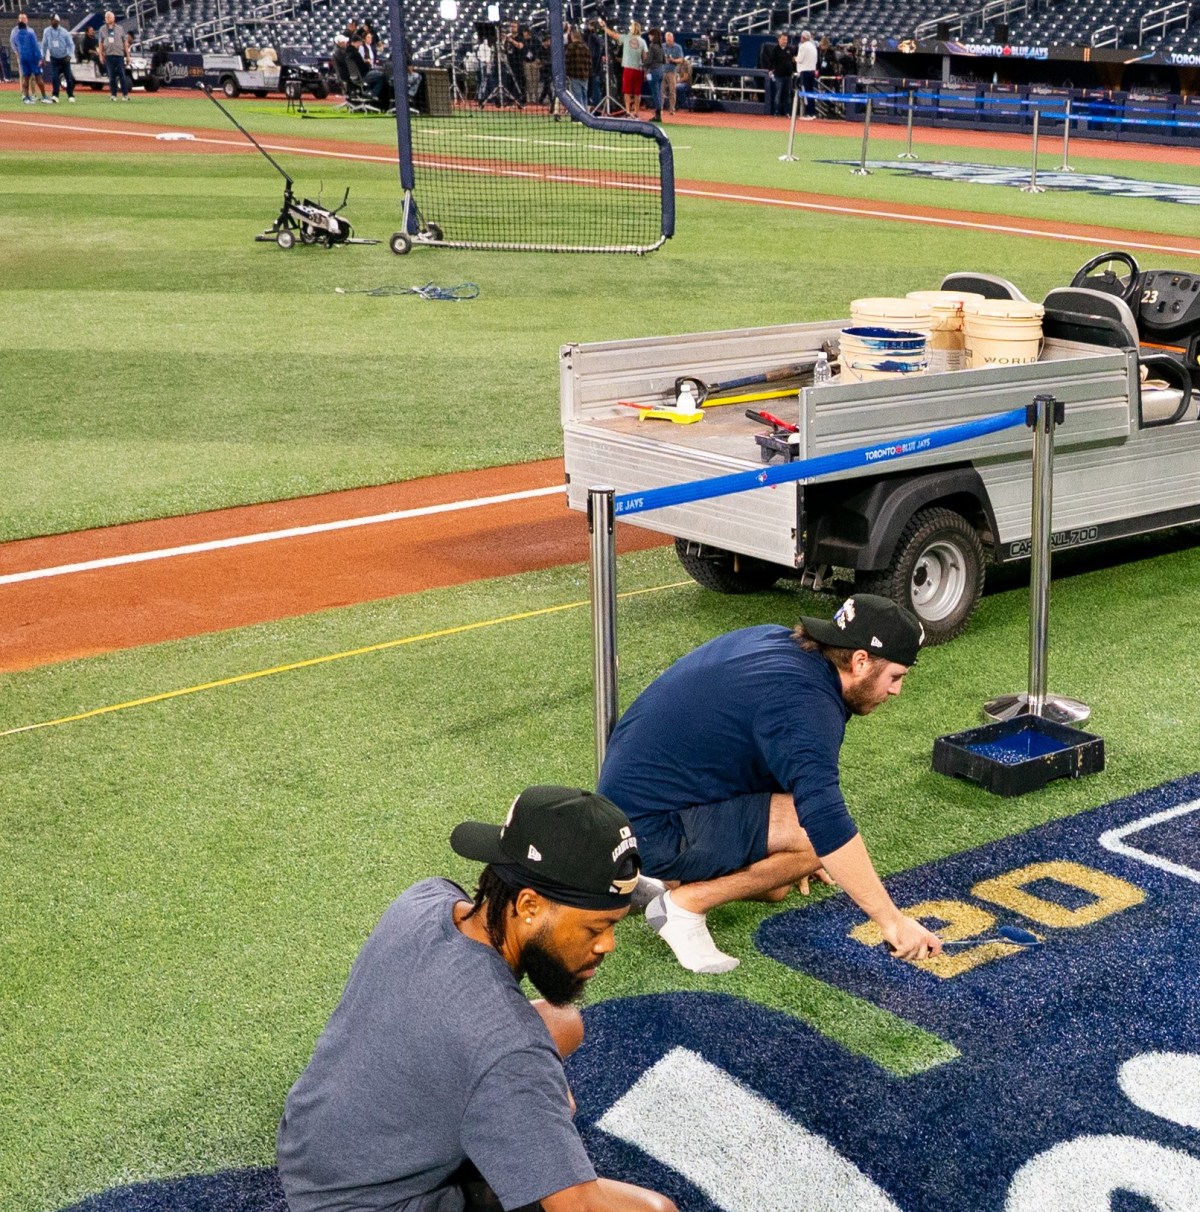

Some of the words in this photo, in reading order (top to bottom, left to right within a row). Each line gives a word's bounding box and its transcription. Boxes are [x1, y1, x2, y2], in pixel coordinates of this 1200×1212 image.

[965, 44, 1002, 55] TORONTO
[1011, 46, 1029, 56] BLUE
[1031, 47, 1048, 57] JAYS
[1141, 290, 1158, 303] 23
[865, 446, 896, 461] TORONTO
[902, 441, 916, 453] BLUE
[916, 438, 930, 450] JAYS
[625, 497, 644, 511] JAYS
[1070, 526, 1098, 545] 700
[848, 859, 1146, 978] 20
